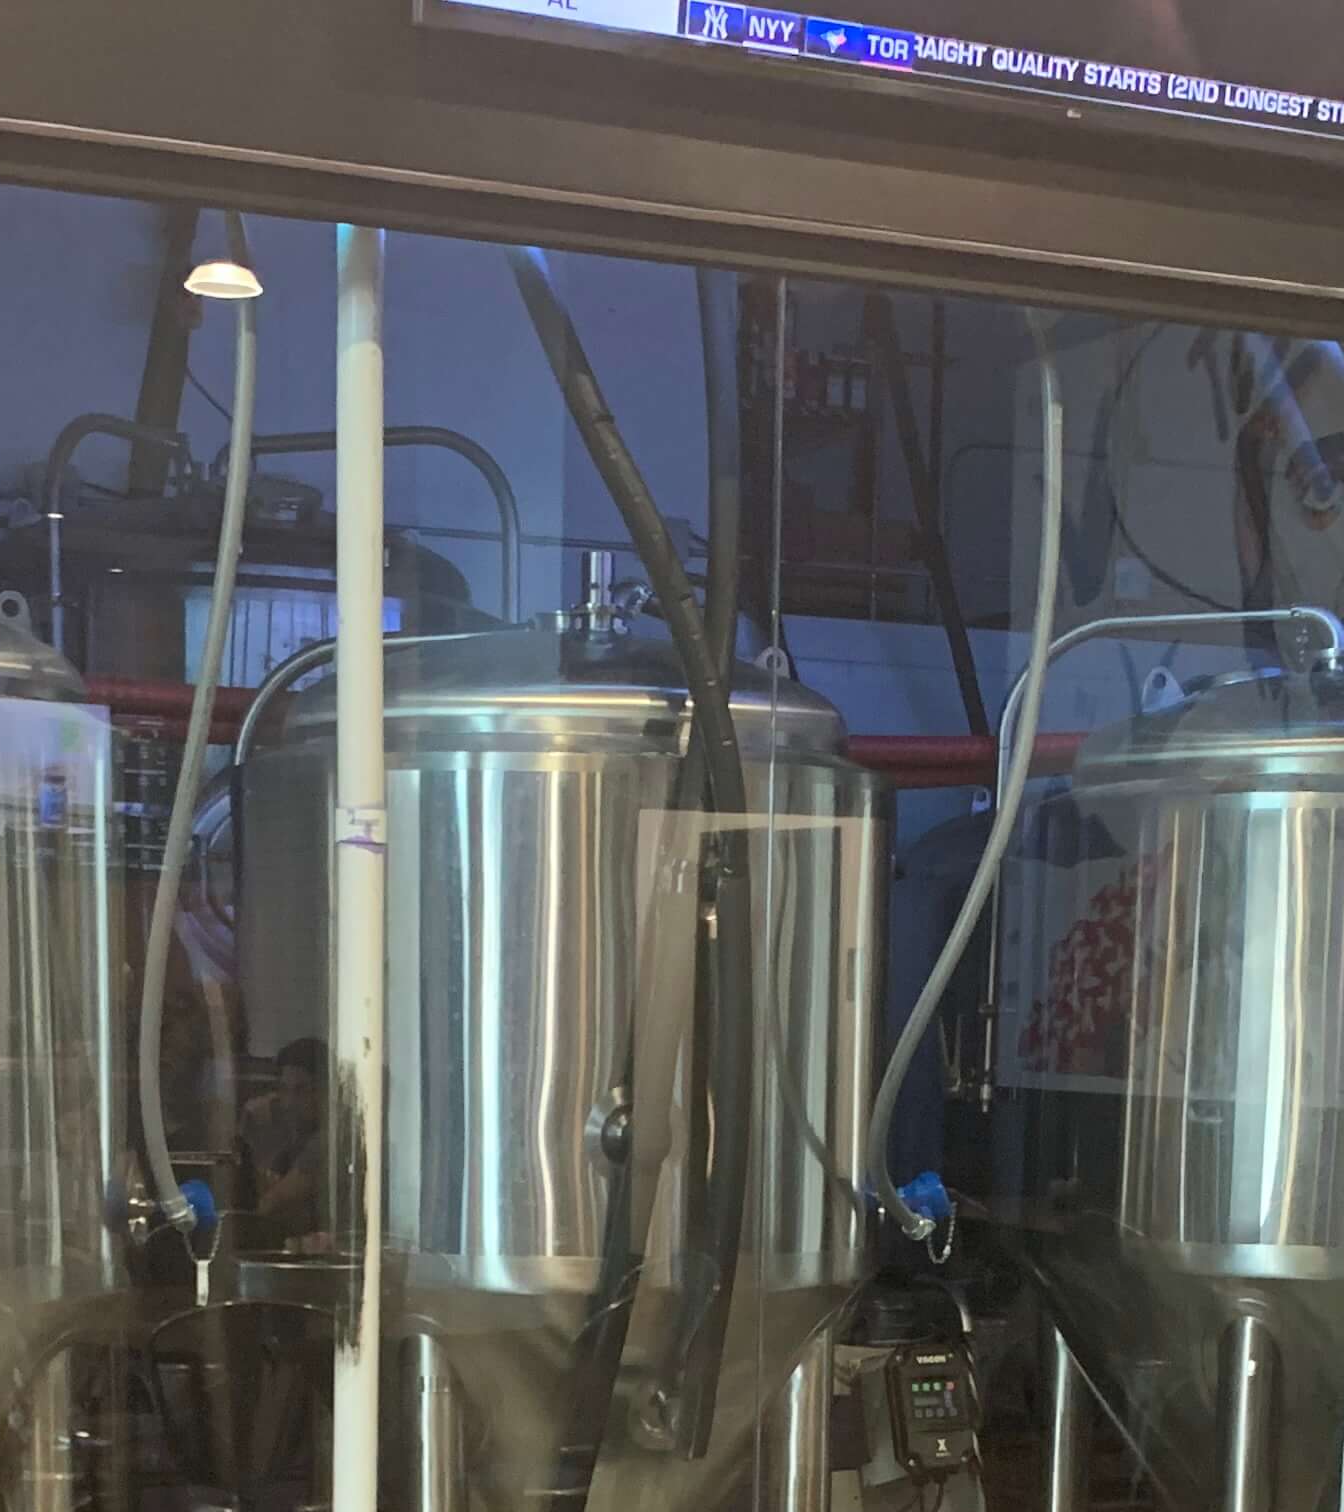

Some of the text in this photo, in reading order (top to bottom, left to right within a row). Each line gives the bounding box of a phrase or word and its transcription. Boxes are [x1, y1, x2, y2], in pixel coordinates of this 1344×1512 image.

[748, 15, 795, 42] NYY
[867, 34, 907, 60] TOR
[992, 48, 1079, 81] QUALITY
[1084, 63, 1161, 95] STARTS
[1167, 73, 1219, 104] (2ND
[1224, 84, 1314, 119] LONGEST
